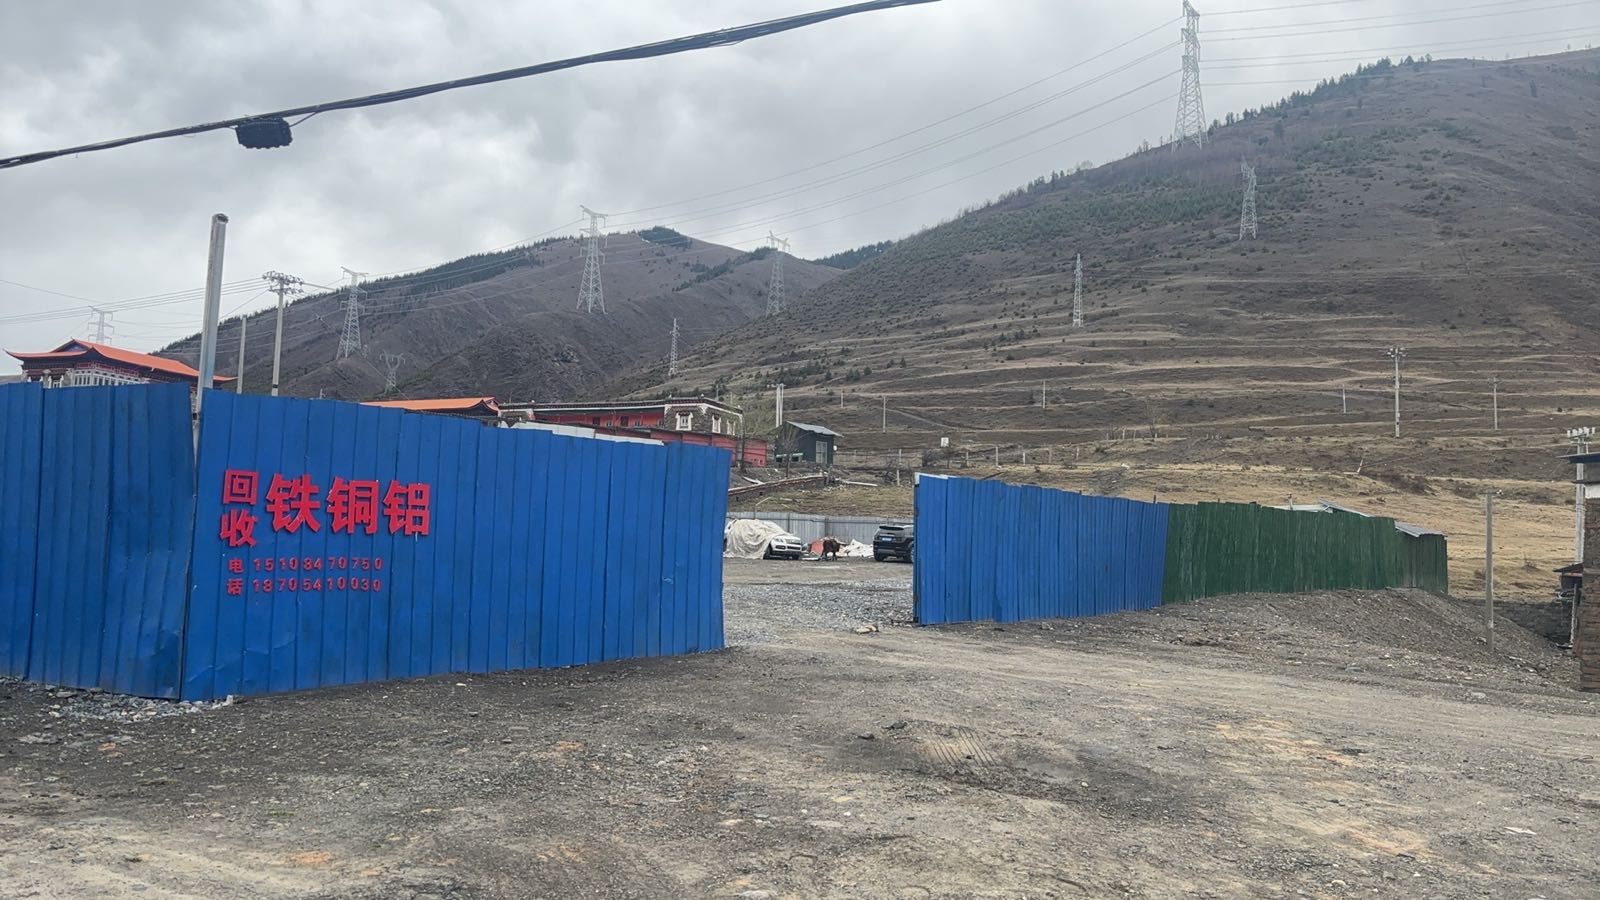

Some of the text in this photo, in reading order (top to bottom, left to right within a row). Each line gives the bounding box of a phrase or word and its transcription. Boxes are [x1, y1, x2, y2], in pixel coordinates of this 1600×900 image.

[220, 469, 258, 547] 回收
[265, 473, 431, 535] 铁铜铝
[227, 558, 243, 595] 电话
